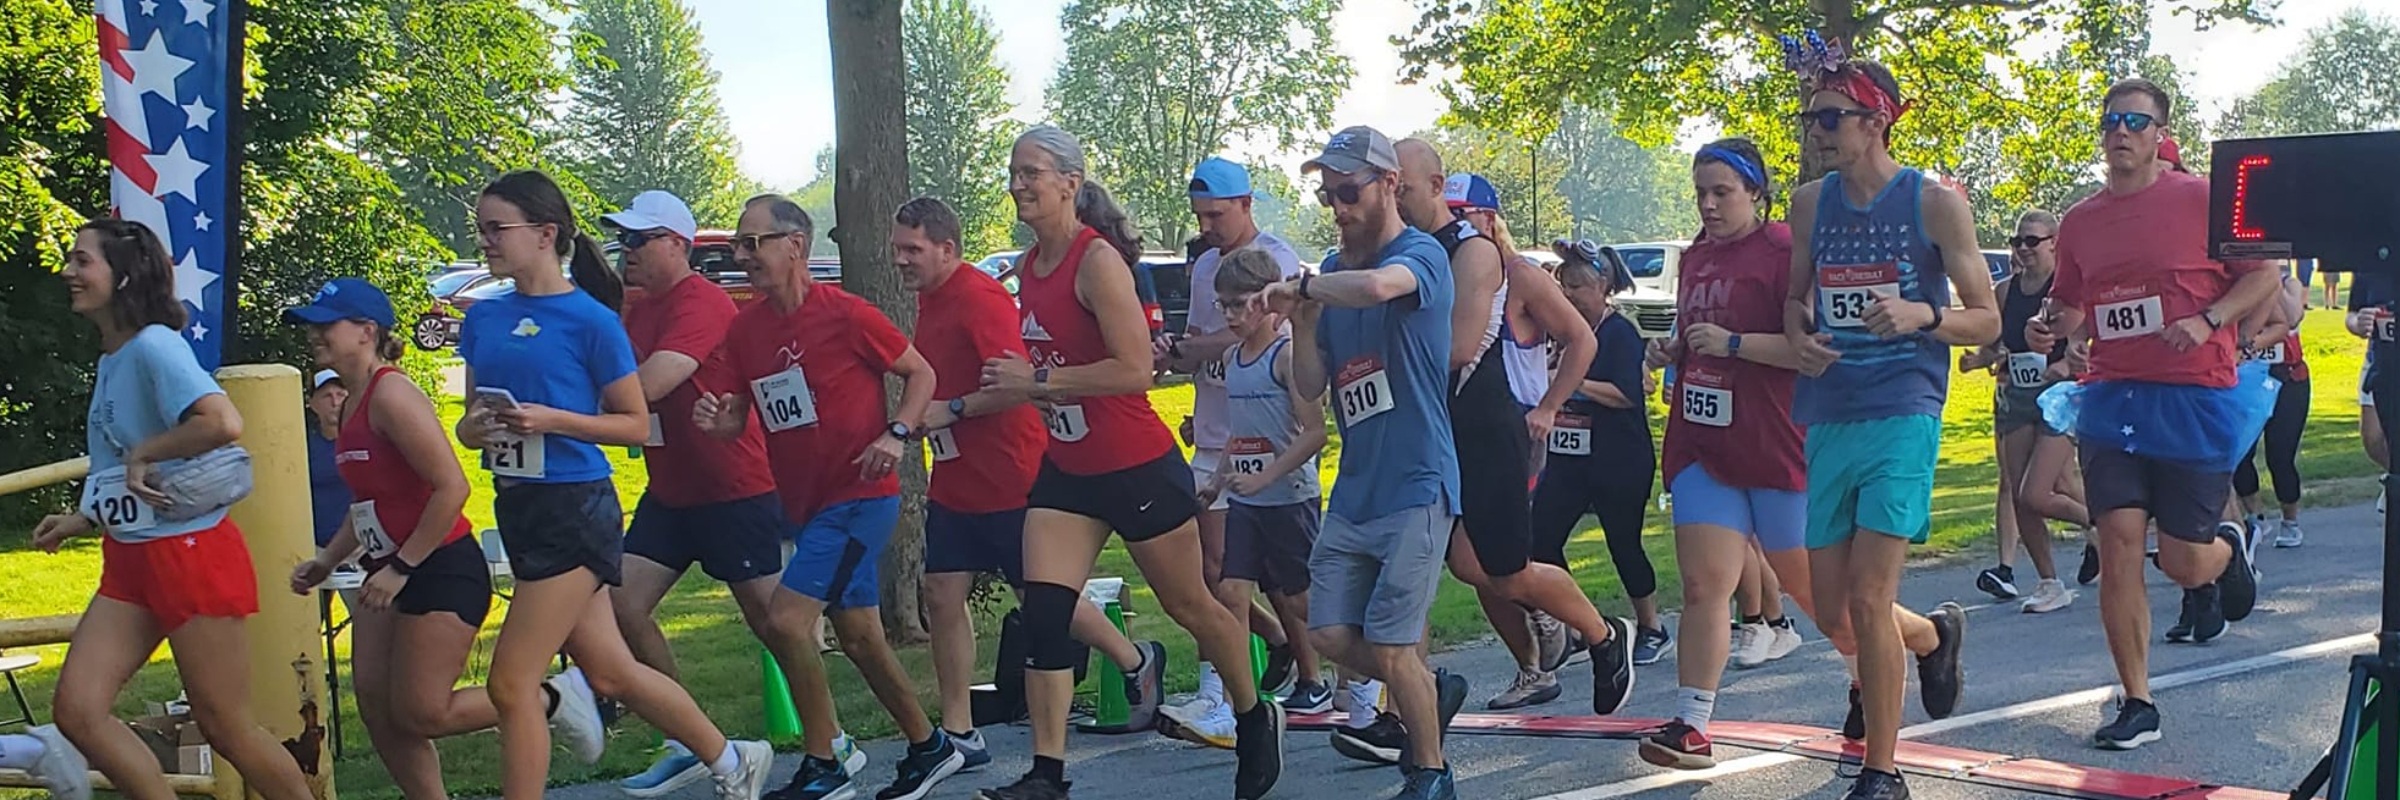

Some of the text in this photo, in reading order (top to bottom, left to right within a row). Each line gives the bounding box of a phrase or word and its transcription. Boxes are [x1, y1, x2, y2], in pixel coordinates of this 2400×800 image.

[1832, 292, 1874, 320] 53
[2107, 304, 2147, 331] 481
[2014, 367, 2041, 384] 102
[766, 395, 802, 424] 104
[1345, 381, 1377, 417] 310
[1685, 390, 1718, 418] 555
[91, 495, 138, 526] 120
